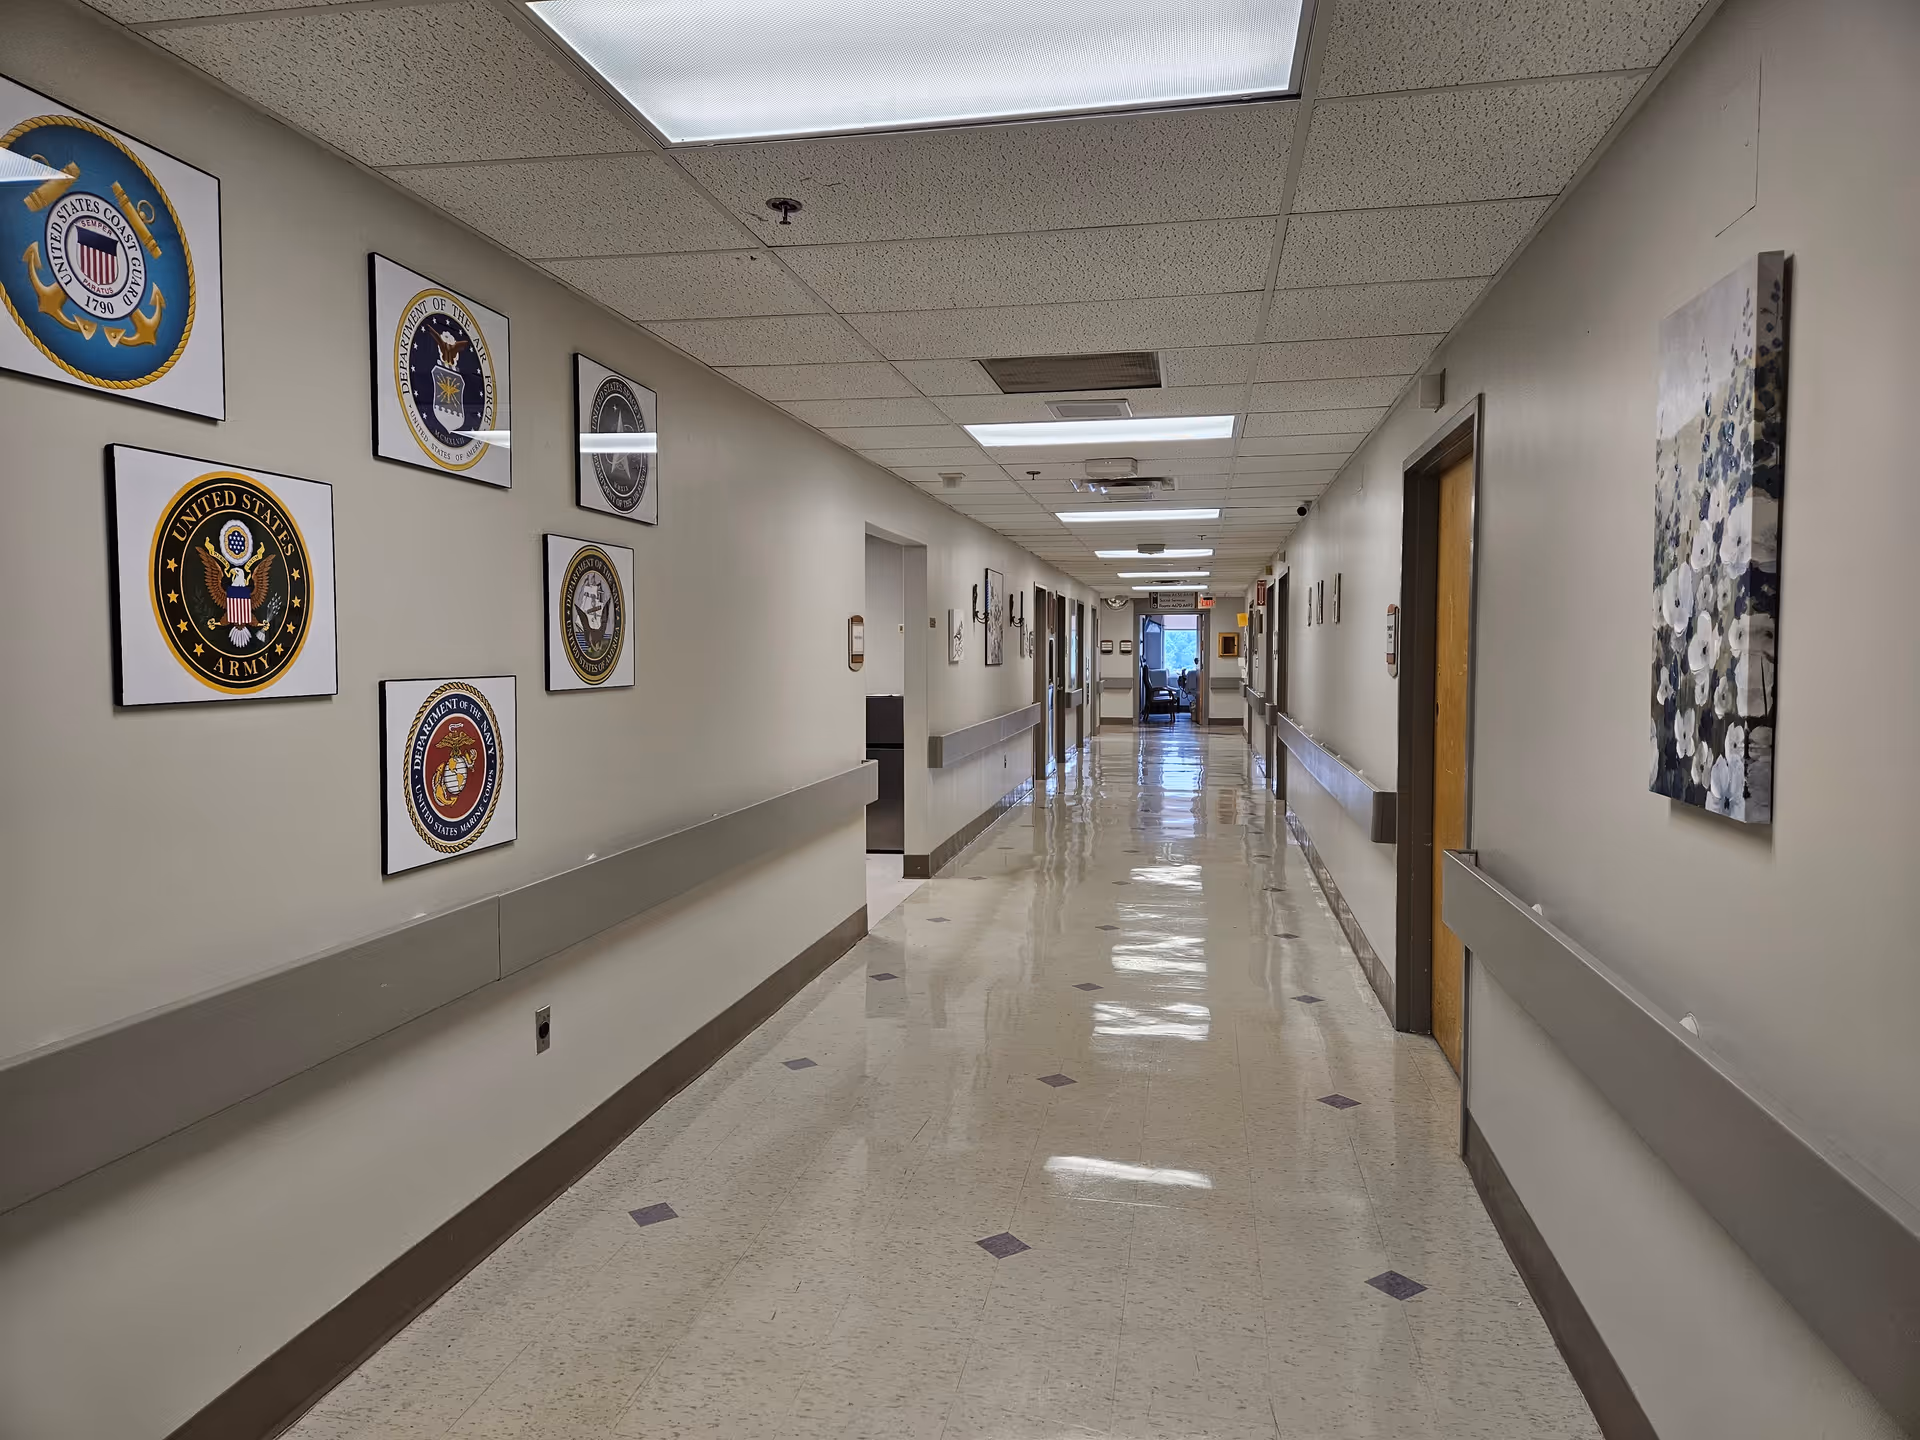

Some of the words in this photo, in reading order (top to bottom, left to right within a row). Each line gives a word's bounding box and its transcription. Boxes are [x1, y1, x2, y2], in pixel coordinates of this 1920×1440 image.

[56, 198, 100, 224] STATES
[81, 219, 113, 237] SEMPER
[103, 207, 138, 252] COAST
[50, 222, 73, 287] UNITED
[82, 278, 114, 294] PARATUS
[84, 295, 114, 315] 1790
[122, 256, 142, 306] GUARD
[399, 300, 428, 395] DEPARTMENT
[432, 297, 446, 311] OF
[451, 304, 472, 332] THE
[473, 338, 487, 364] AIR
[483, 375, 493, 426] FORCE
[410, 410, 429, 442] UNITED
[430, 443, 451, 460] STATES
[455, 453, 463, 462] OF
[171, 489, 237, 543] UNITED
[242, 493, 296, 557] STATES
[566, 558, 594, 607] DEPARTMENT
[213, 653, 271, 677] ARMY
[413, 698, 459, 770] DEPARTMENT
[459, 700, 468, 710] OF
[469, 703, 483, 721] THE
[480, 720, 495, 755] NAVY
[414, 784, 434, 825] UNITED
[433, 821, 458, 836] STATES
[459, 803, 485, 834] MARINE
[483, 769, 494, 803] CORPS
